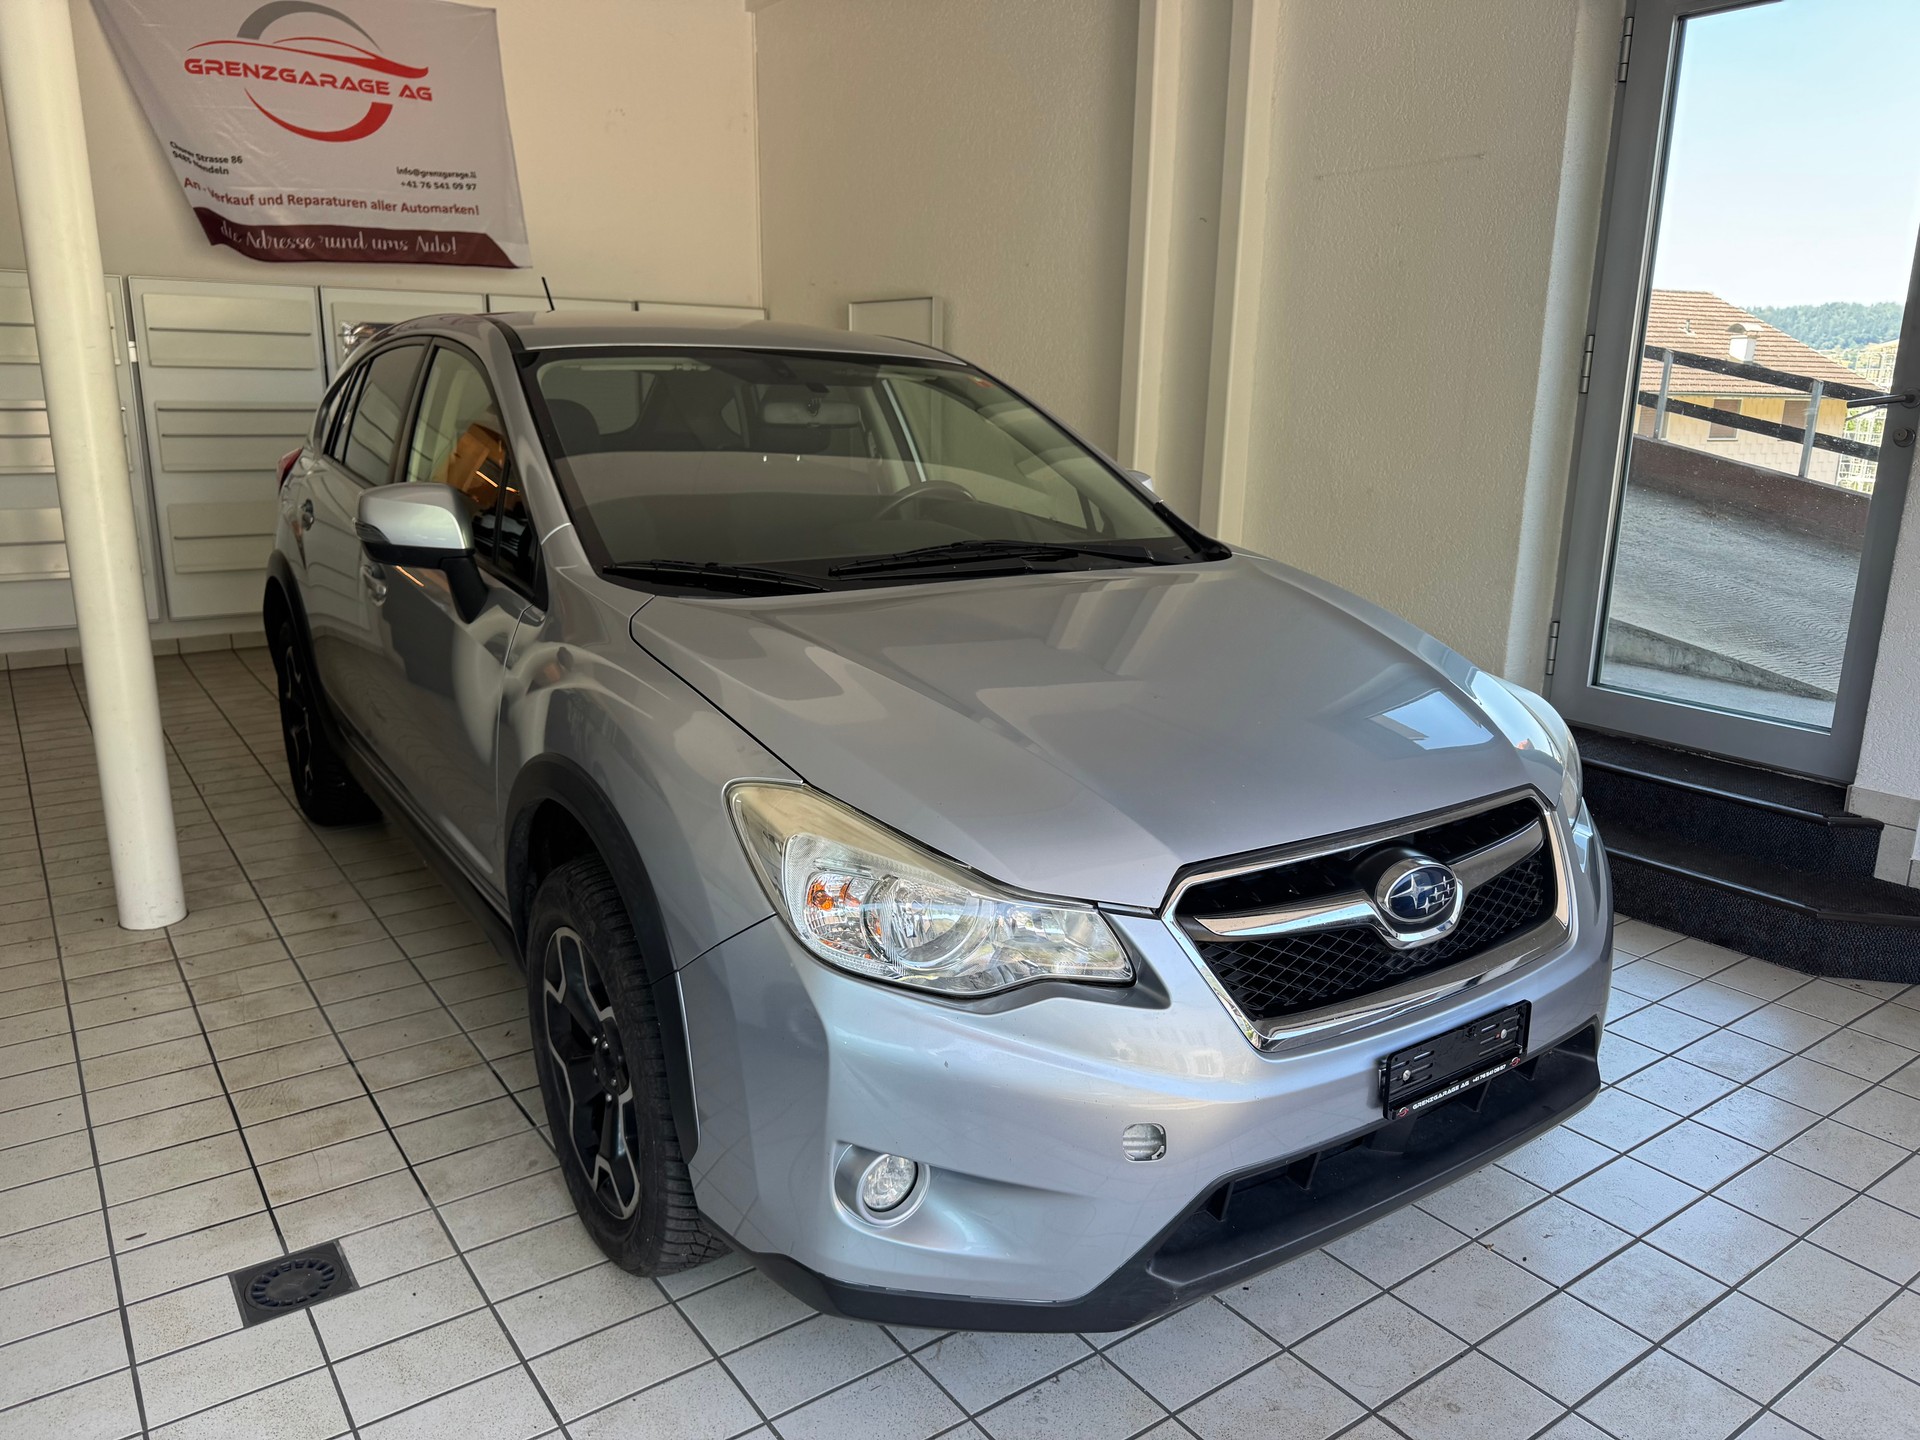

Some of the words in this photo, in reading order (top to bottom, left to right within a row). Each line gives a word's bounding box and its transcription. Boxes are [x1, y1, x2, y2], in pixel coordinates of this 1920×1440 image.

[184, 58, 391, 96] GRENZGARAGE
[398, 84, 433, 101] AG
[195, 153, 229, 164] Strasse
[231, 155, 243, 164] 86
[401, 180, 418, 189] +41
[420, 181, 432, 189] 76
[434, 181, 450, 190] 541
[465, 183, 477, 191] 97
[258, 194, 283, 206] und
[287, 194, 368, 210] Reparaturen
[370, 199, 398, 212] aller
[400, 202, 480, 216] Automarken!
[220, 220, 242, 243] die
[246, 229, 316, 250] Adresse
[319, 231, 369, 250] rund
[372, 237, 409, 251] ums
[415, 235, 457, 255] Auto!
